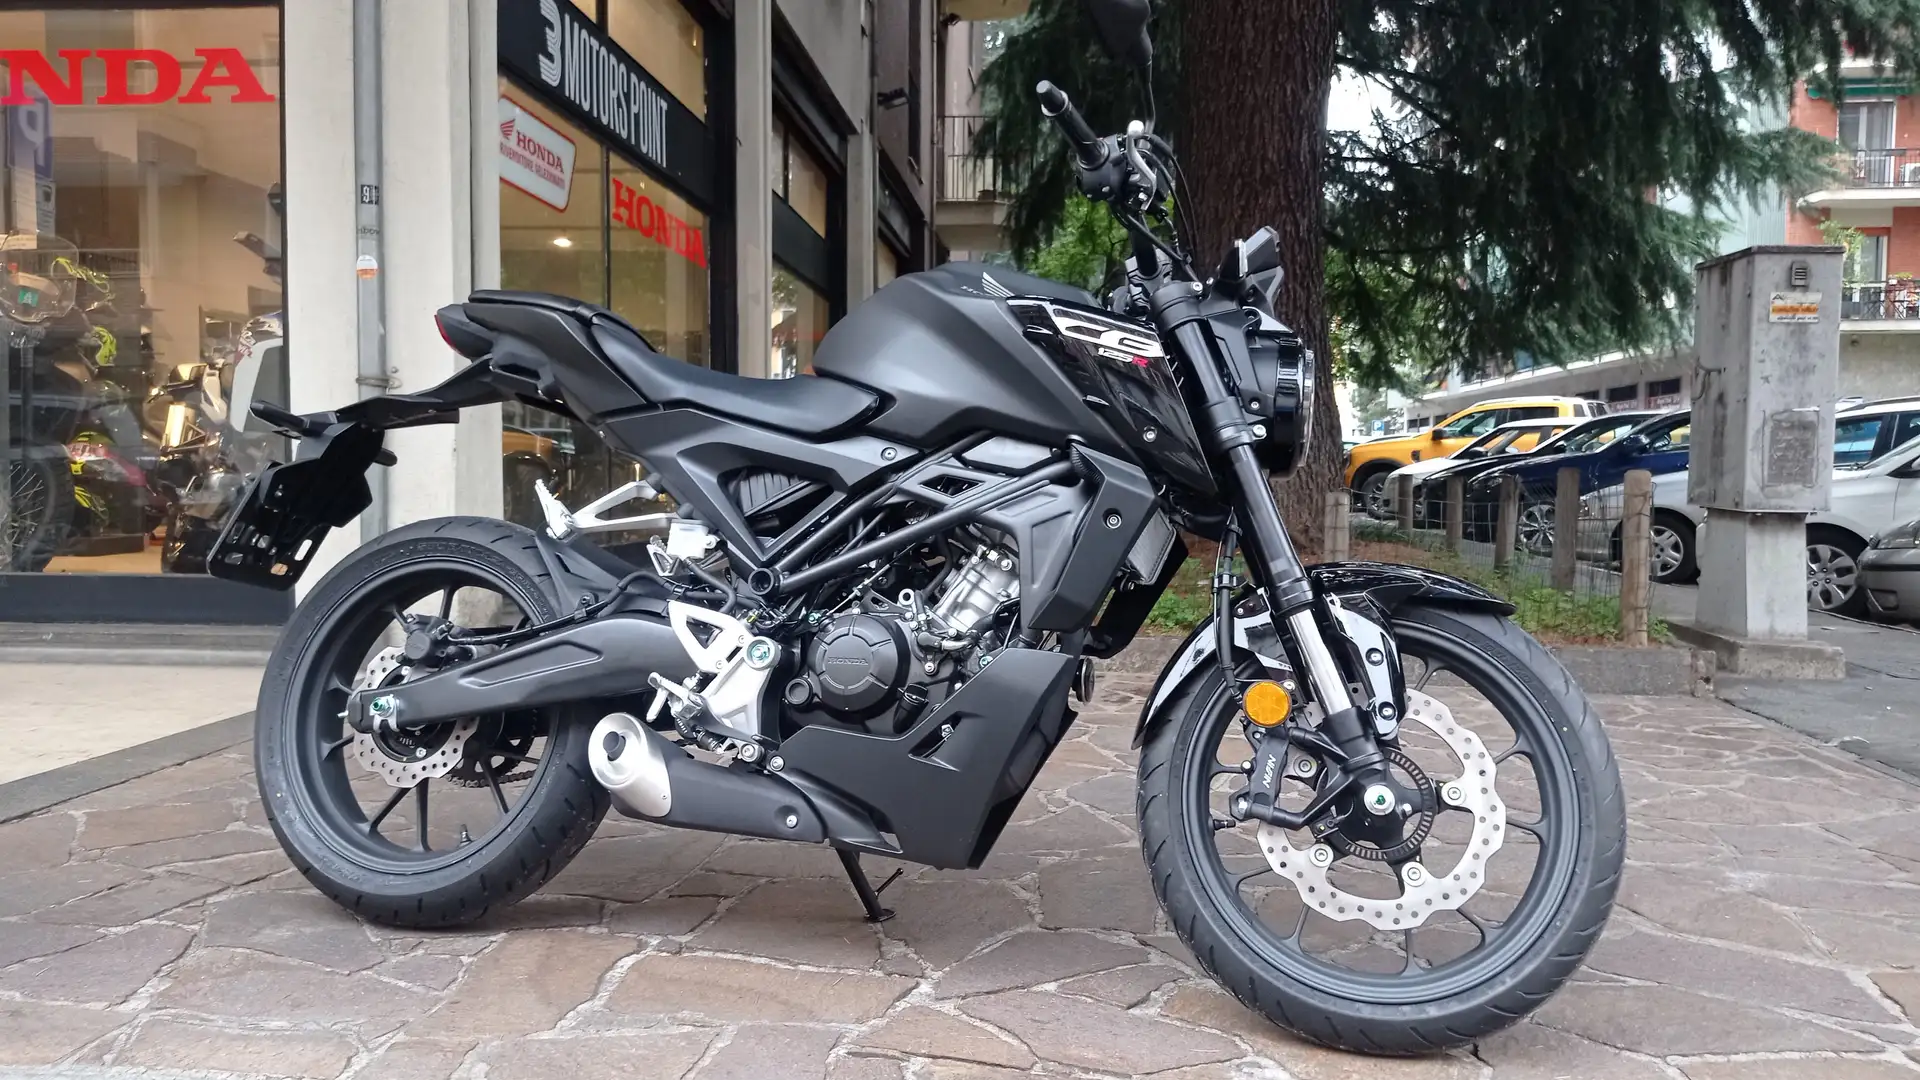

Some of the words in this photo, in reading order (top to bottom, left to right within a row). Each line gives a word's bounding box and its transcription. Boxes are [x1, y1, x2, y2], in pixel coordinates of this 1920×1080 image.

[0, 48, 276, 105] NDA
[516, 129, 565, 174] HONDA
[612, 178, 707, 269] HONDA
[1053, 315, 1164, 358] CB
[1097, 347, 1149, 368] 125R
[827, 656, 869, 666] HONDA
